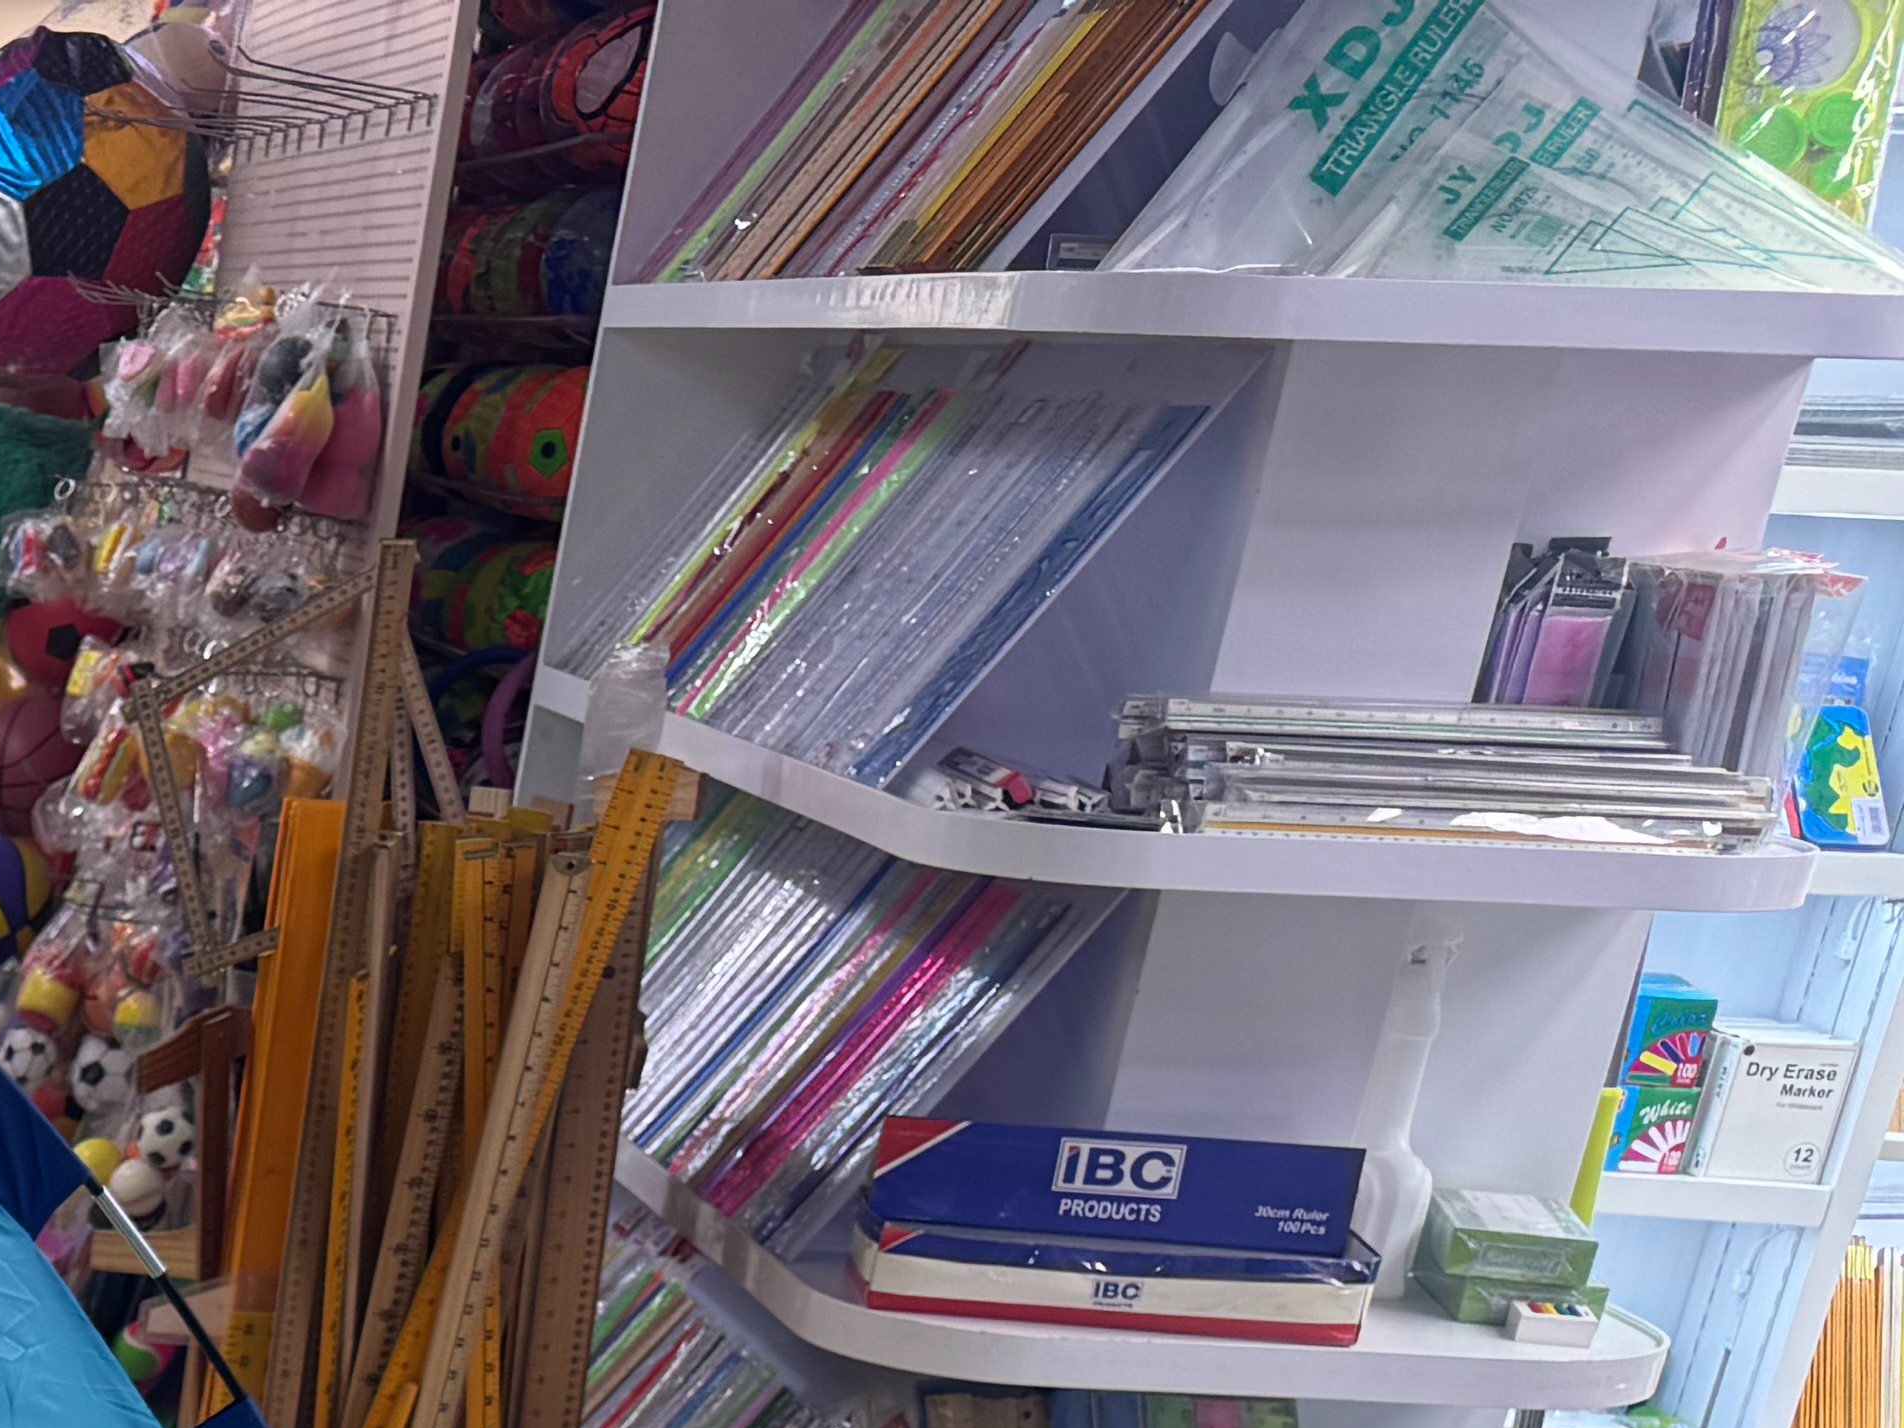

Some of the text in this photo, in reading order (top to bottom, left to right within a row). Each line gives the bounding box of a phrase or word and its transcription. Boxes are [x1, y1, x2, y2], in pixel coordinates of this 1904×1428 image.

[1322, 64, 1415, 177] TRIANGLE
[1438, 164, 1478, 205] JY
[1746, 1062, 1779, 1082] Dry
[1783, 1063, 1837, 1082] Erase
[1780, 1084, 1834, 1099] Marker
[1793, 1148, 1814, 1164] 12
[1062, 1144, 1177, 1192] IBC
[1058, 1198, 1162, 1223] PRODUCTS
[1254, 1204, 1330, 1222] 30cm Ruler
[1094, 1280, 1141, 1301] IBC
